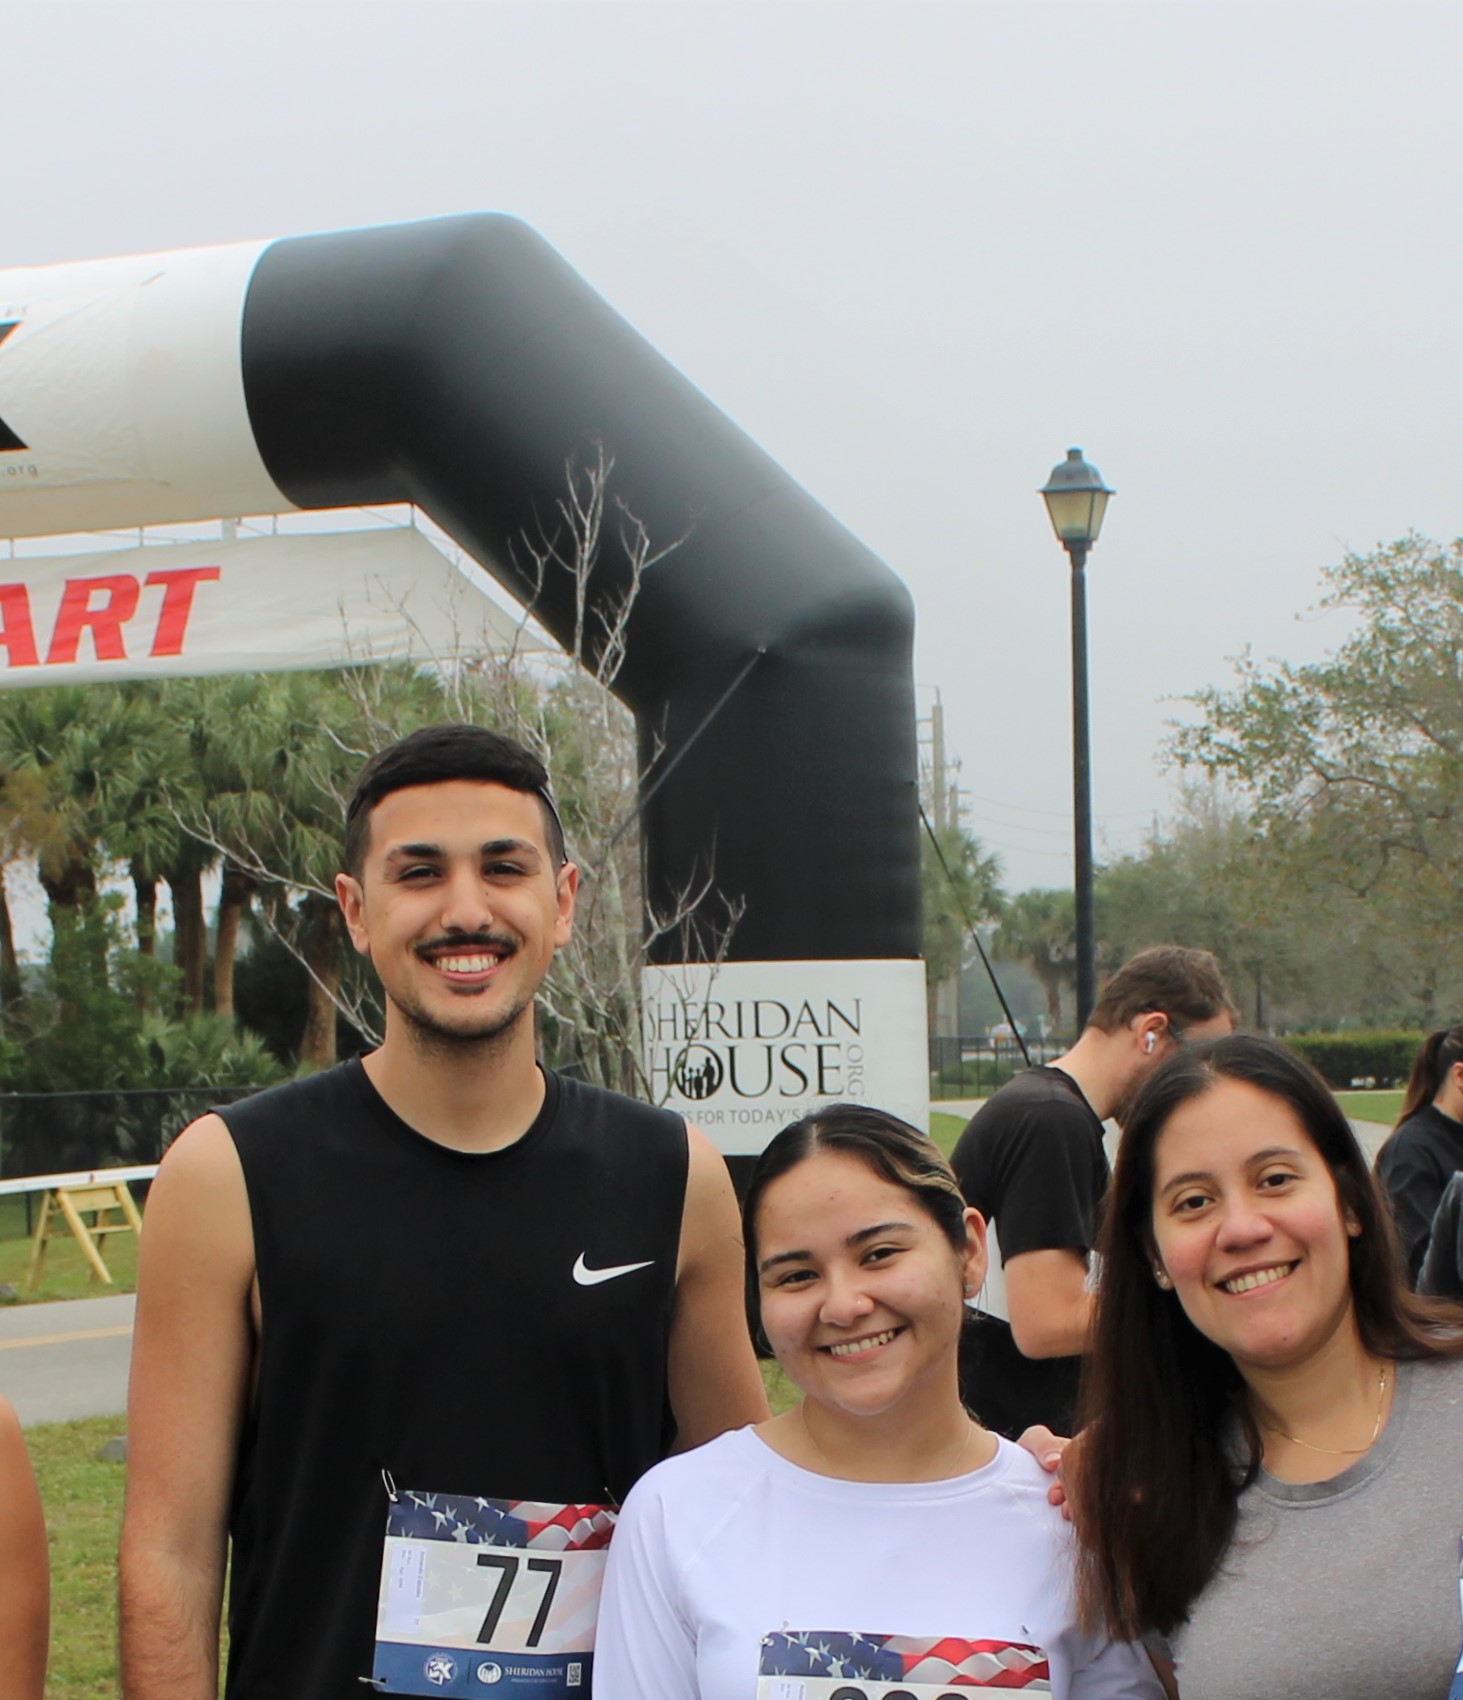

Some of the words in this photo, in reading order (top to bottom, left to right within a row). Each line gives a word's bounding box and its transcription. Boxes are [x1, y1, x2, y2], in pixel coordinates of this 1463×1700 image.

[646, 997, 863, 1042] SHERIDAN
[648, 1042, 845, 1101] HOUSE
[696, 1109, 725, 1125] FOR
[729, 1107, 802, 1125] TODAY'S
[476, 1553, 563, 1648] 77
